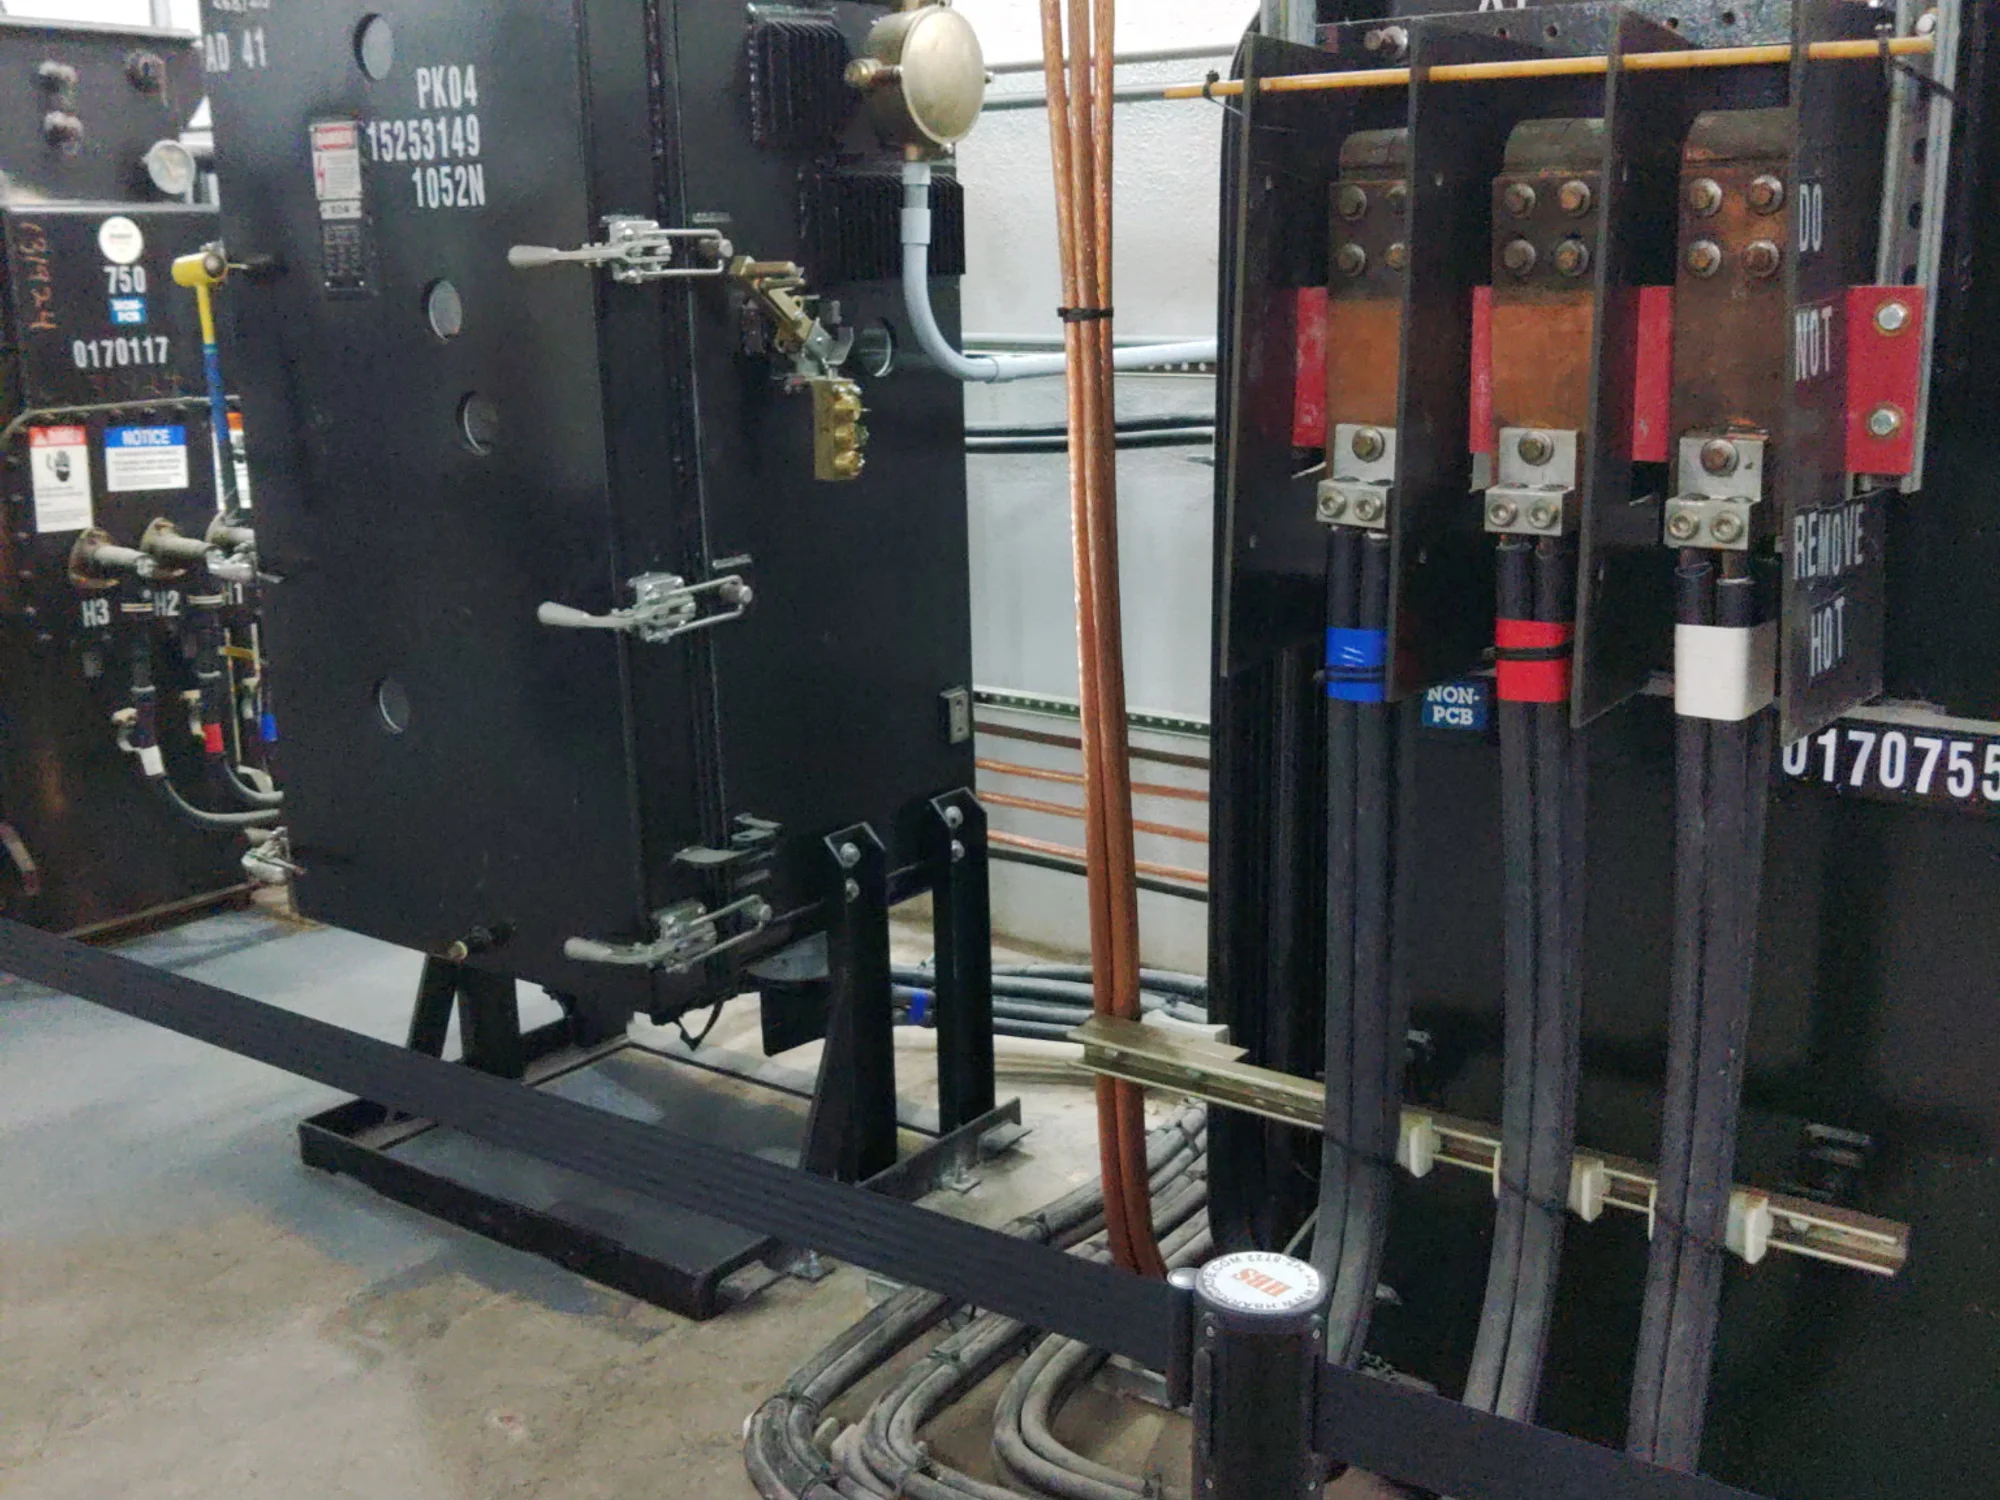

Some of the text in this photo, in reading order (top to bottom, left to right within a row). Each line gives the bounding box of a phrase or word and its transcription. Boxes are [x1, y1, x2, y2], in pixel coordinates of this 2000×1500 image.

[241, 27, 266, 69] 41
[416, 64, 478, 109] PK04
[365, 113, 480, 162] 15253149
[412, 163, 486, 209] 1052N
[1800, 183, 1823, 252] DO
[103, 265, 147, 295] 750
[73, 335, 169, 369] 0170117
[1796, 305, 1833, 382] NOT
[121, 428, 172, 446] NOTICE
[1794, 503, 1865, 580] REMOVE
[82, 598, 110, 627] H3
[154, 589, 180, 617] H2
[1809, 595, 1845, 678] HOT
[1427, 684, 1480, 705] NON-
[1432, 704, 1474, 725] PCB
[1783, 728, 2000, 801] 0170755
